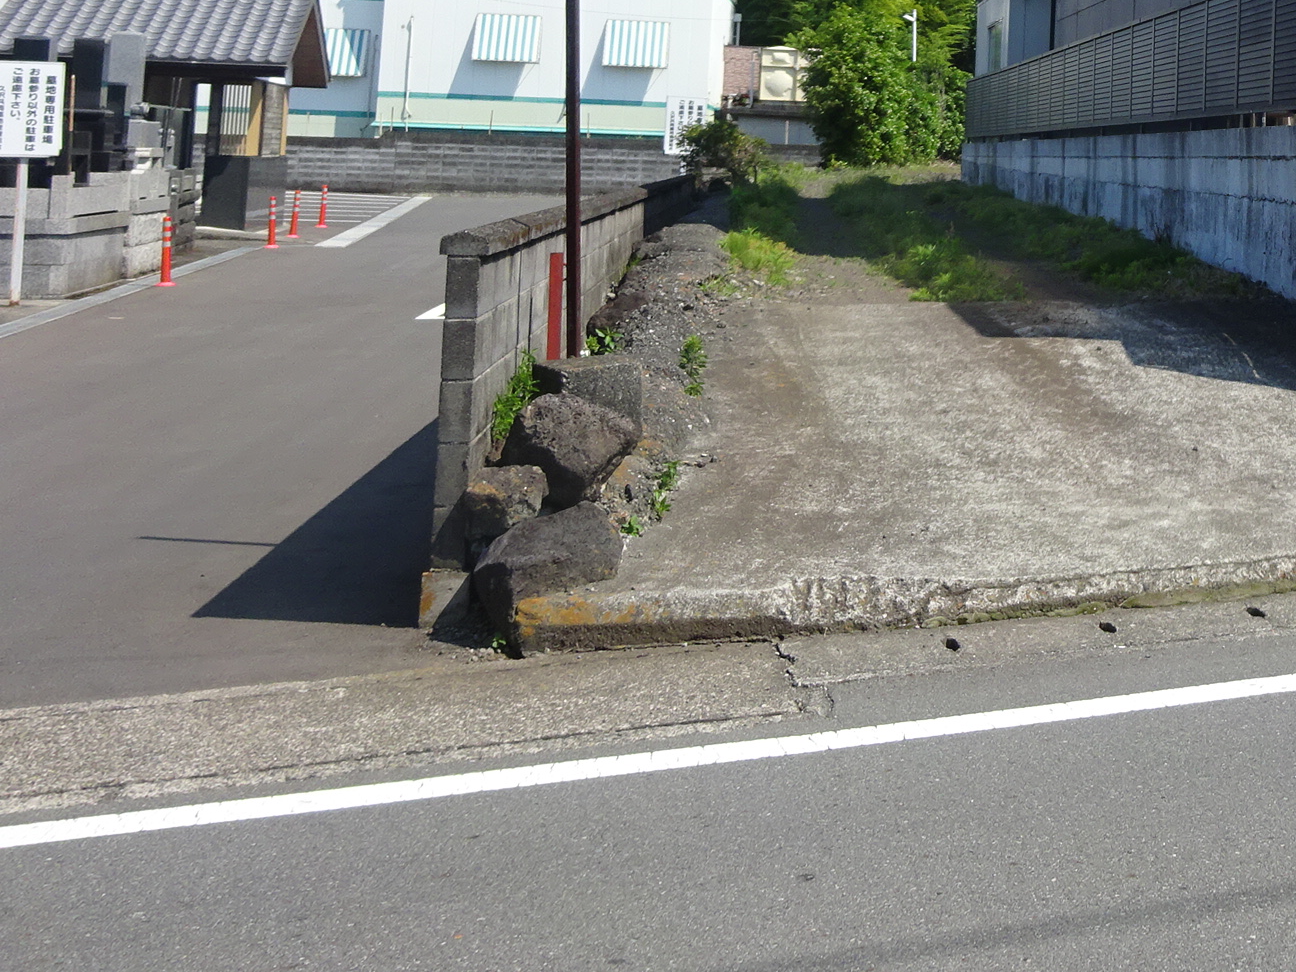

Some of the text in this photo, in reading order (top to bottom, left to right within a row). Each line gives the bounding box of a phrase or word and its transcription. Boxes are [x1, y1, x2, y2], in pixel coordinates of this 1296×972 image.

[24, 68, 41, 151] お墓参り以外の駐車は
[41, 75, 57, 144] 墓地専用駐車場
